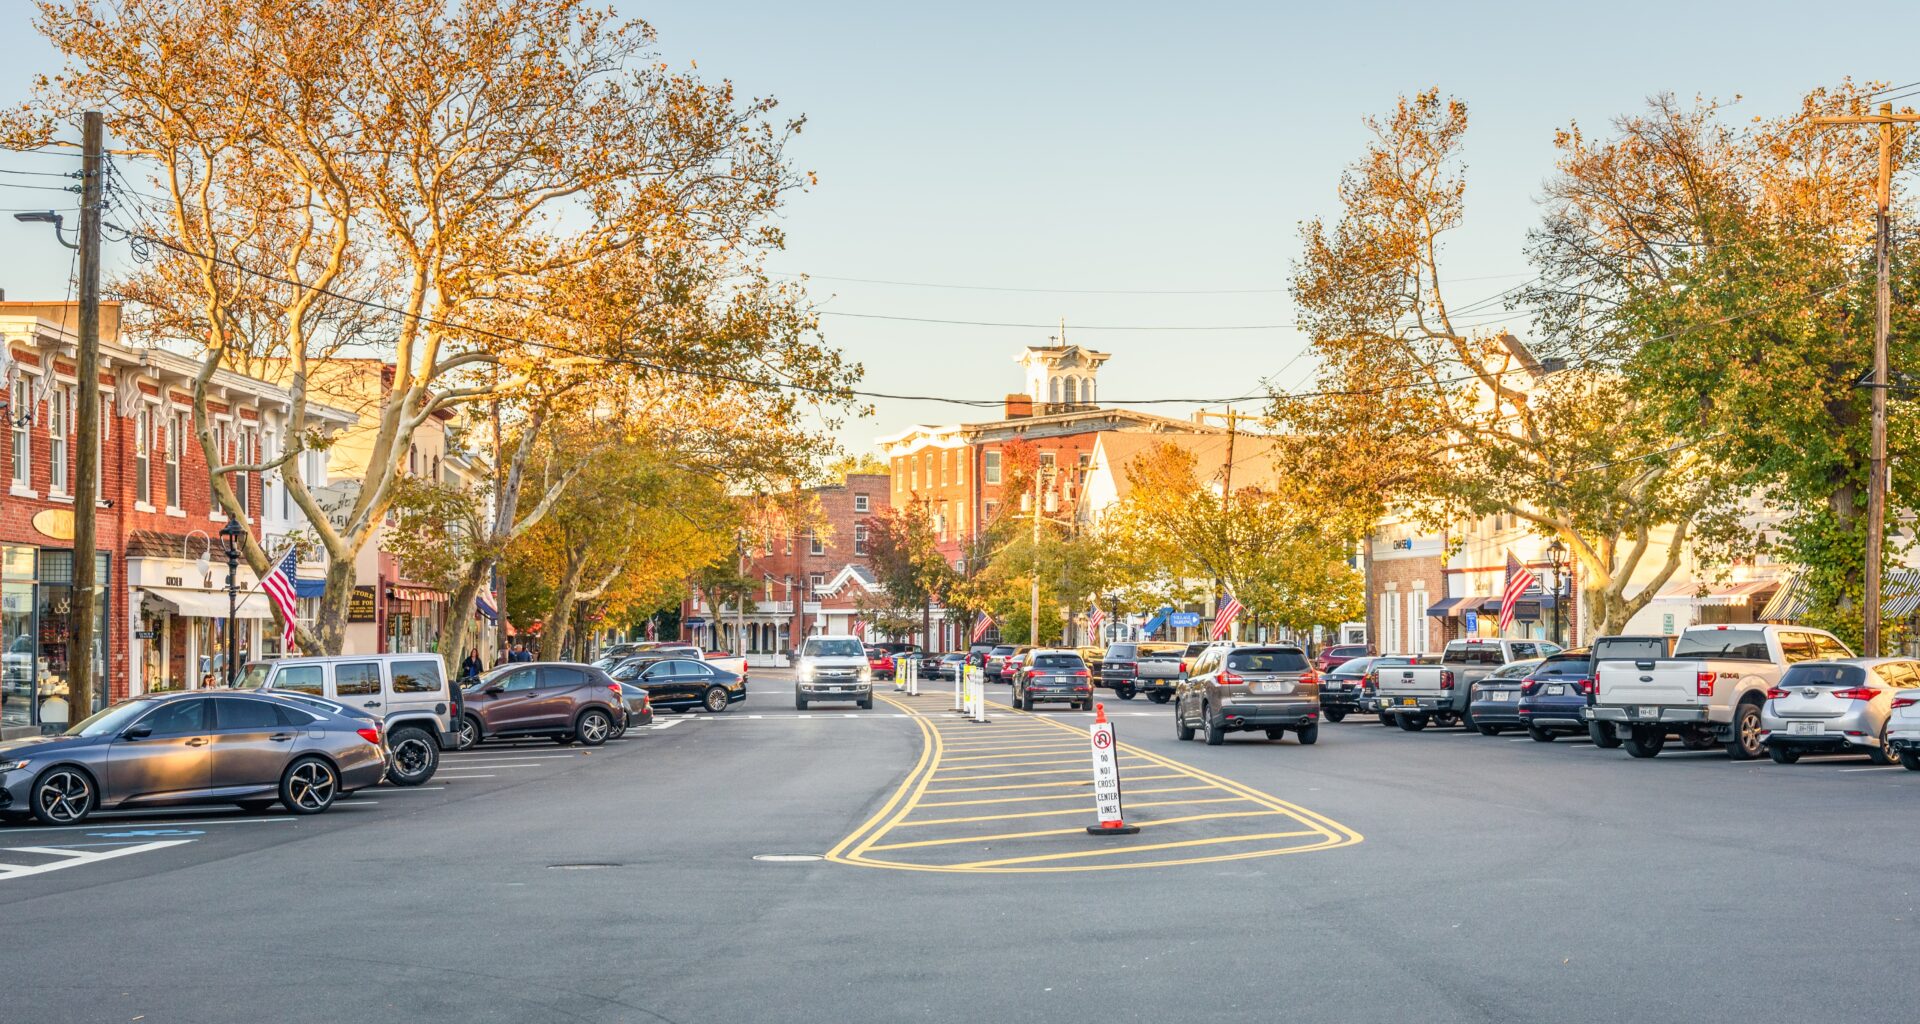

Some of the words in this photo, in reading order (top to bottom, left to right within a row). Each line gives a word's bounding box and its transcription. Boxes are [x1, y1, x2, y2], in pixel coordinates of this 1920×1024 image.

[1393, 540, 1406, 550] CHASE
[166, 576, 182, 586] KITCHEN
[1101, 754, 1109, 762] DO
[1100, 767, 1111, 775] NOT
[1098, 780, 1115, 788] CROSS
[1097, 792, 1118, 801] CENTER
[1101, 805, 1117, 814] LINES
